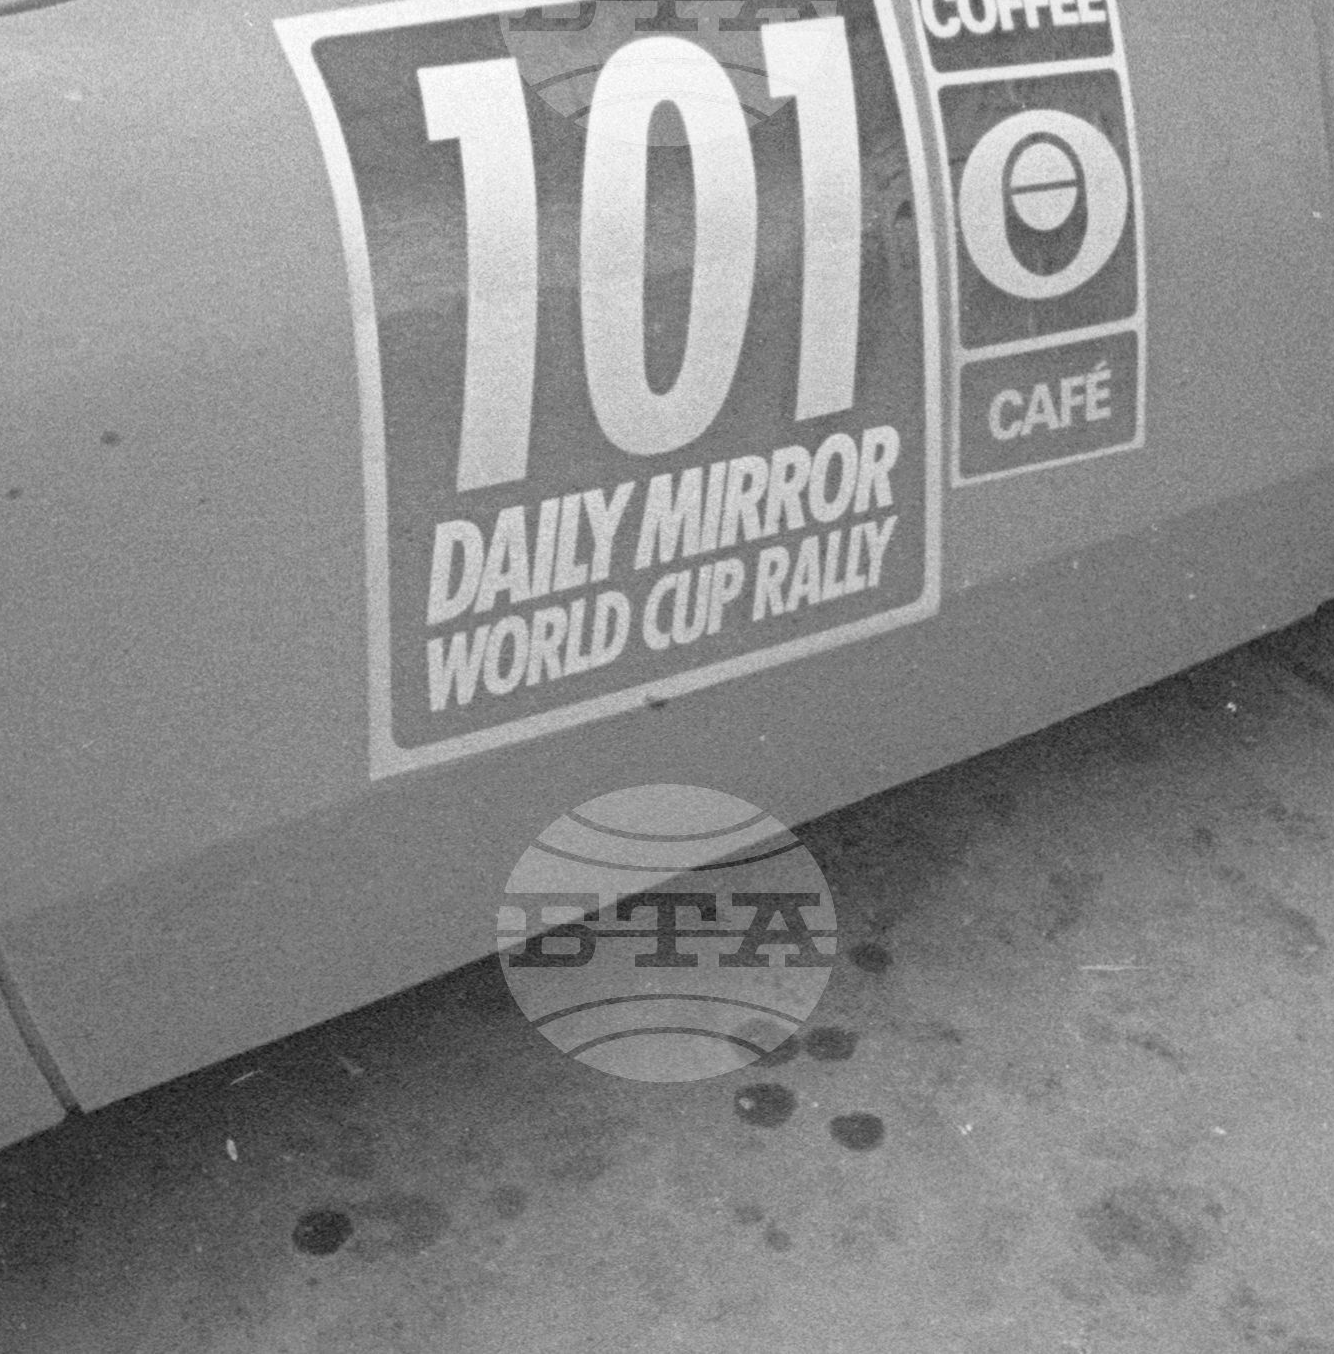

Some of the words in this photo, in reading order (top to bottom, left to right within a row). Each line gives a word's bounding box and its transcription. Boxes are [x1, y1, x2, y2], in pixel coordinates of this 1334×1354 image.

[416, 14, 862, 495] 101
[989, 359, 1112, 441] CAFÉ
[426, 480, 636, 626] DAILY
[633, 424, 901, 571] MIRROR
[426, 590, 632, 713] WORLD
[643, 557, 746, 651] CUP
[752, 514, 899, 622] RALLY
